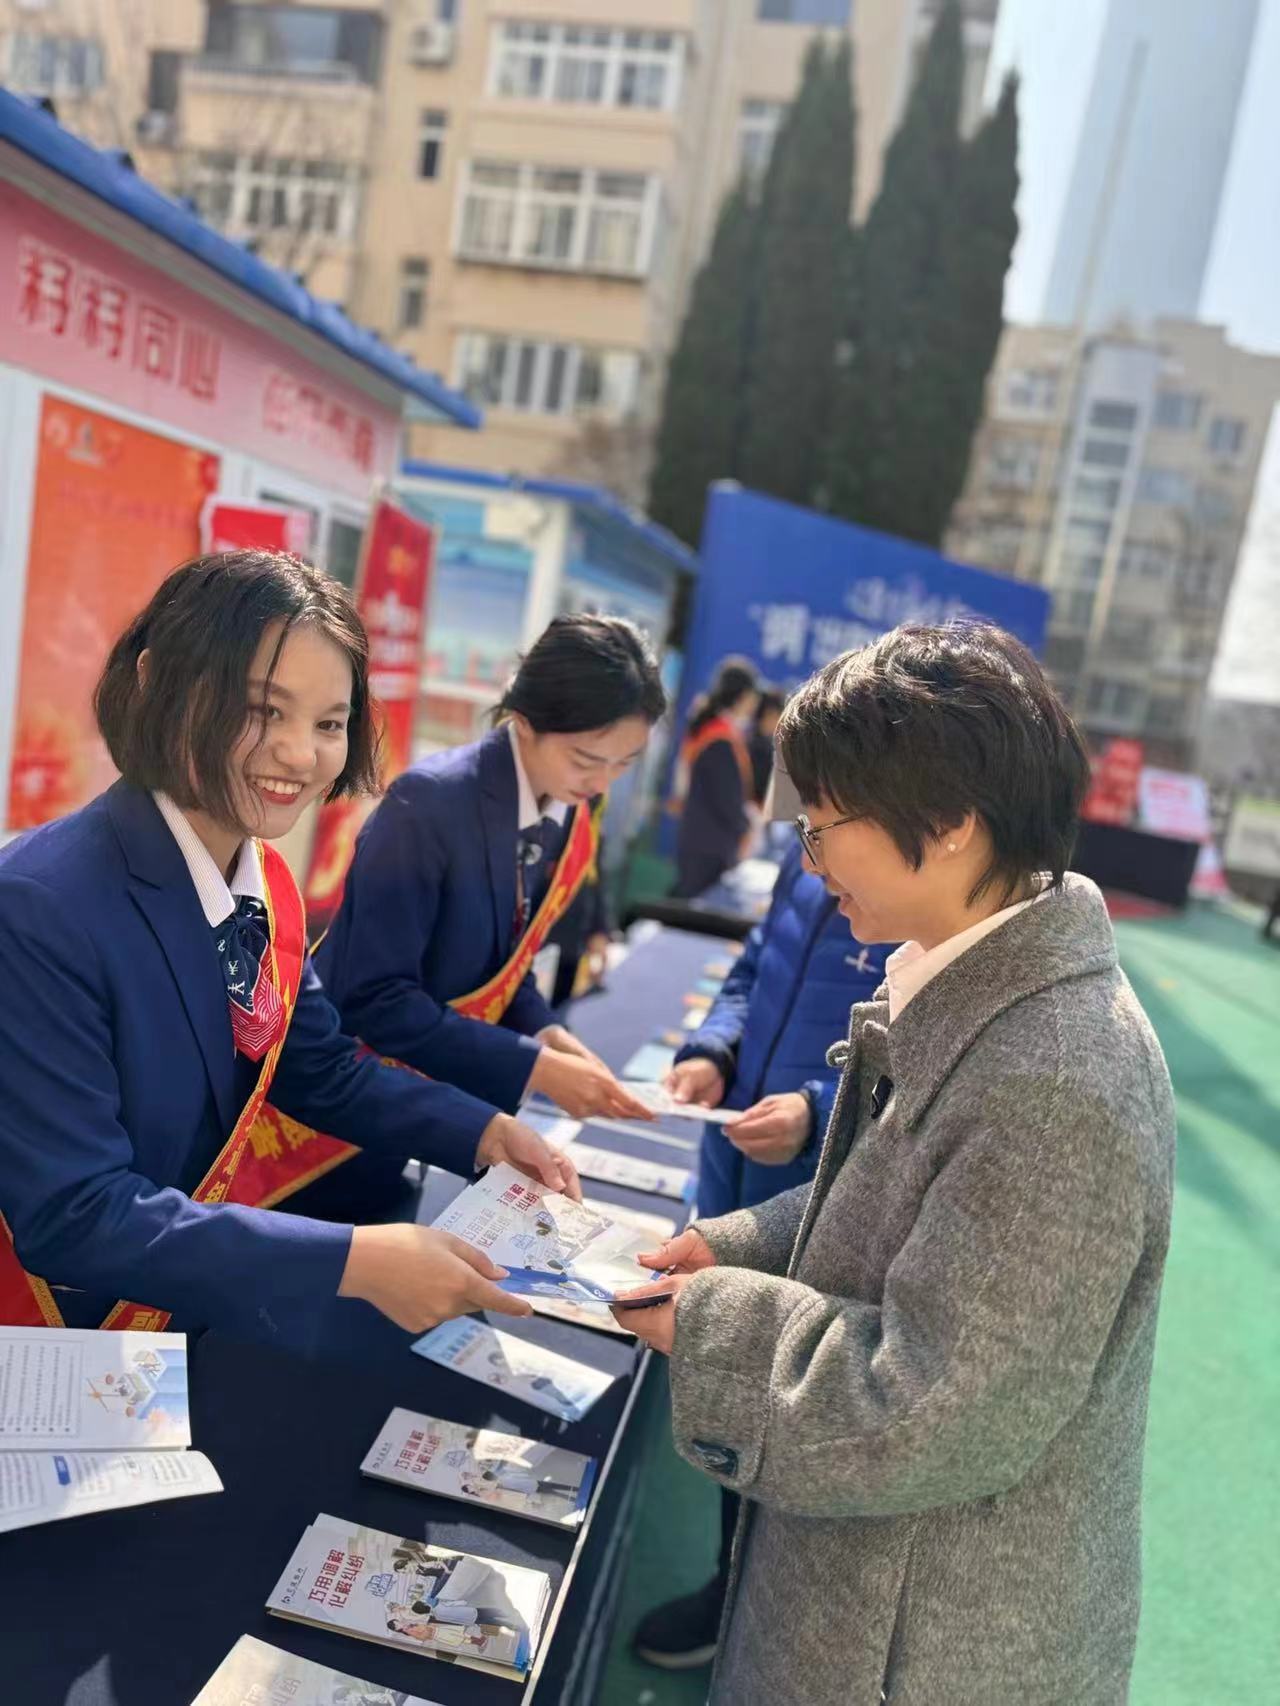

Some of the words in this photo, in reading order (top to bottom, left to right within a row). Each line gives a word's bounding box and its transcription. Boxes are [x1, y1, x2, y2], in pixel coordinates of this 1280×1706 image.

[307, 1549, 345, 1603] 巧用调解
[328, 1554, 365, 1608] 化解纠纷
